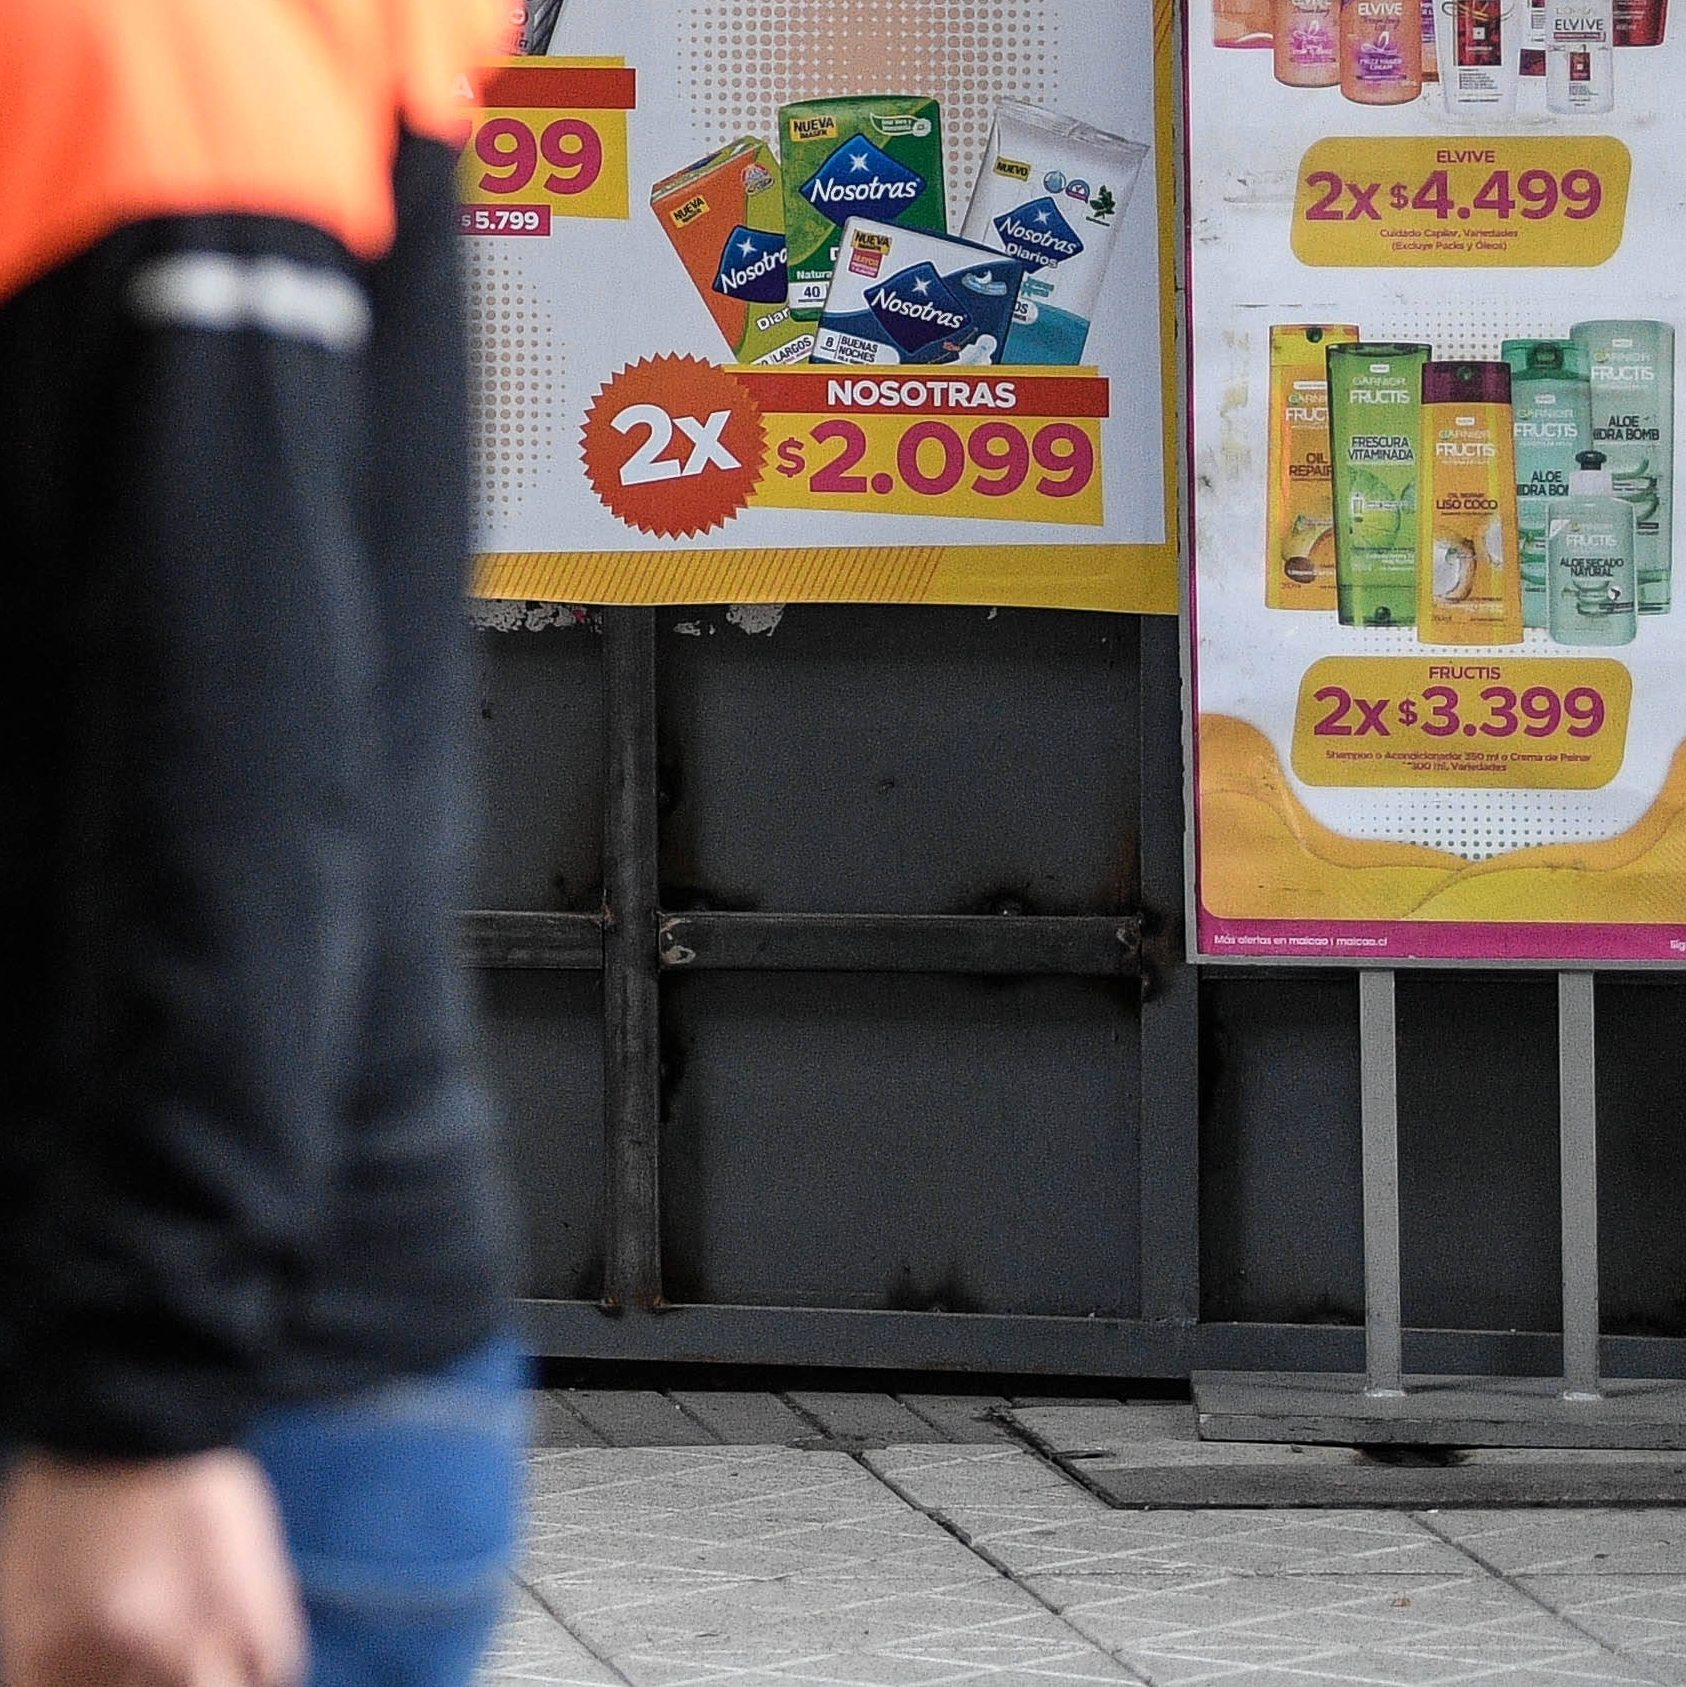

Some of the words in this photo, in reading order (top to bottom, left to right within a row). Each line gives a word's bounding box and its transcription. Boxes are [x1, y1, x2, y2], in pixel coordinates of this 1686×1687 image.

[1436, 149, 1496, 164] ELVIVE
[810, 175, 918, 205] Nosotras
[1389, 169, 1603, 221] $4.499
[827, 380, 1016, 408] NOSOTRAS
[1347, 448, 1414, 462] VITAMINADA
[1352, 436, 1410, 449] FRESCURA
[776, 420, 1095, 497] $2.099
[1428, 666, 1501, 680] FRUCTIS
[1398, 685, 1605, 738] $3.399
